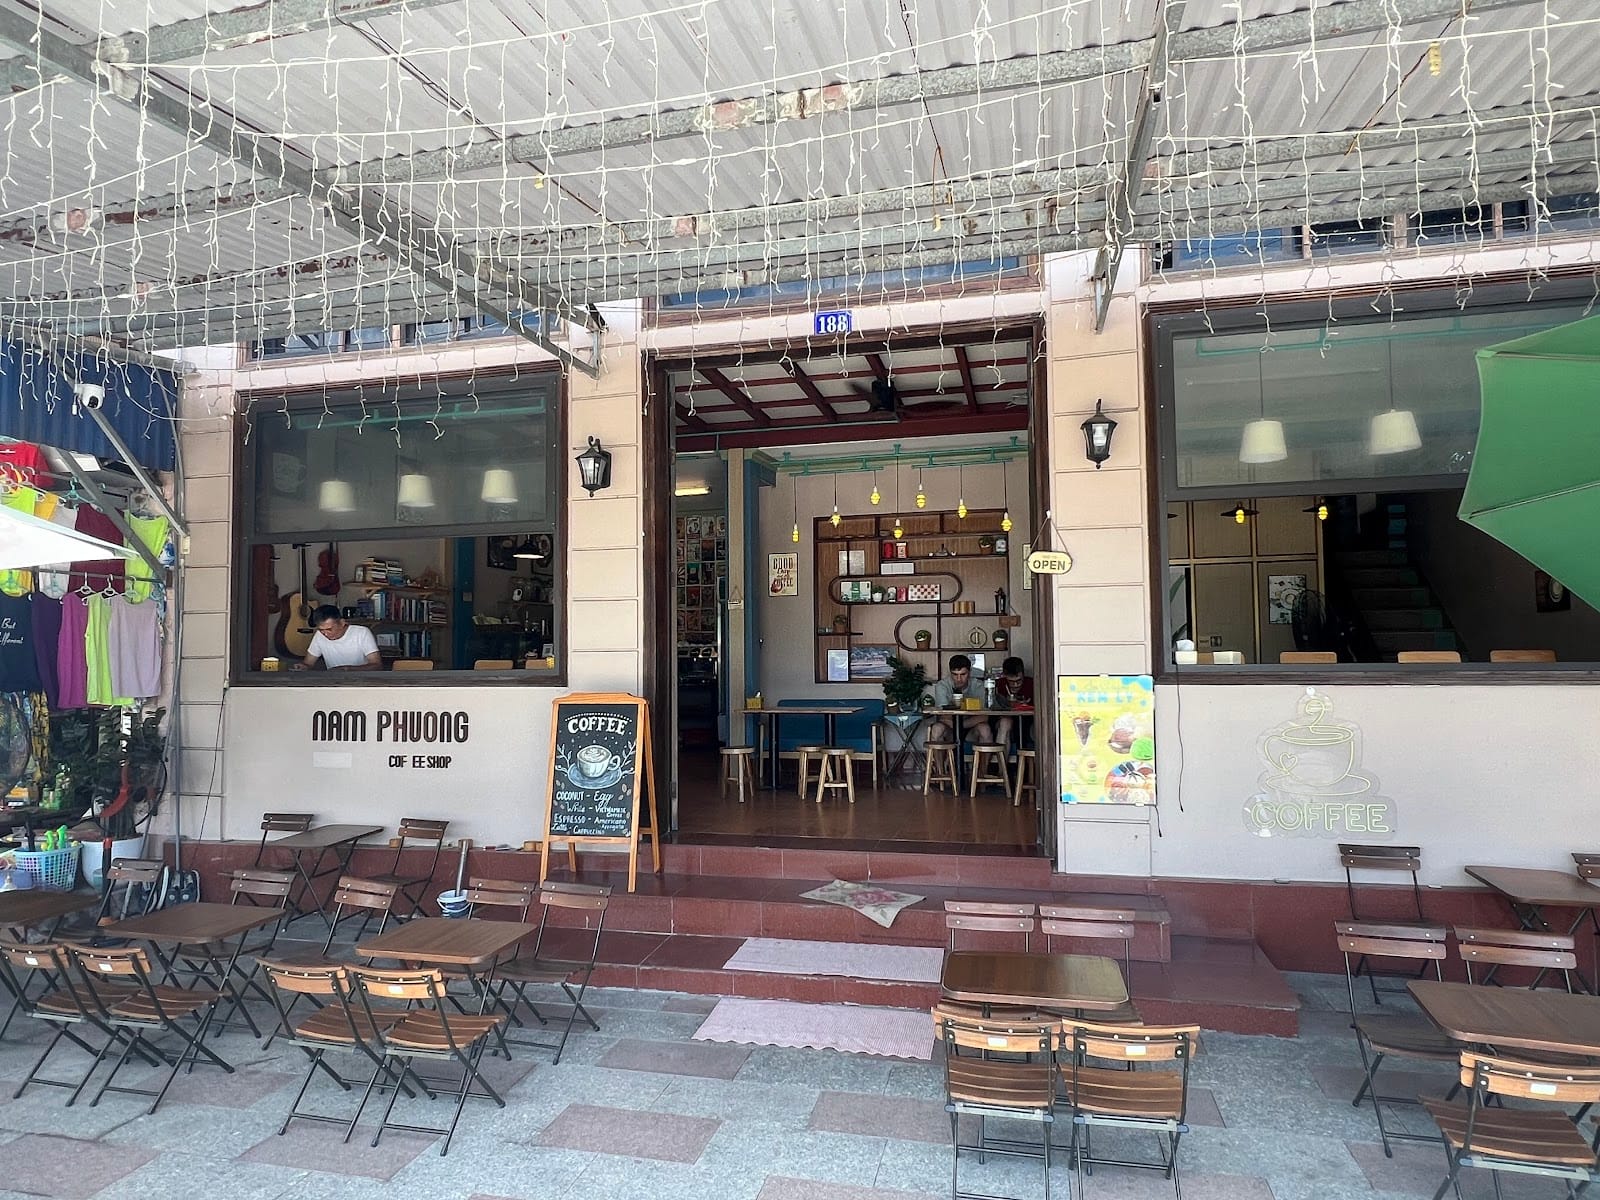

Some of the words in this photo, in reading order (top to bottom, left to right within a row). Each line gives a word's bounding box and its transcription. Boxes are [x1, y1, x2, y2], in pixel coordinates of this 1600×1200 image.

[818, 314, 847, 333] 188
[1033, 560, 1065, 570] OPEN
[312, 710, 367, 742] NAM
[376, 711, 469, 743] PHUONG
[568, 716, 628, 736] COFFEE
[556, 791, 585, 801] COCONUT
[593, 790, 614, 807] Egg
[554, 813, 587, 824] ESPRESSO
[1251, 802, 1390, 833] COFFEE
